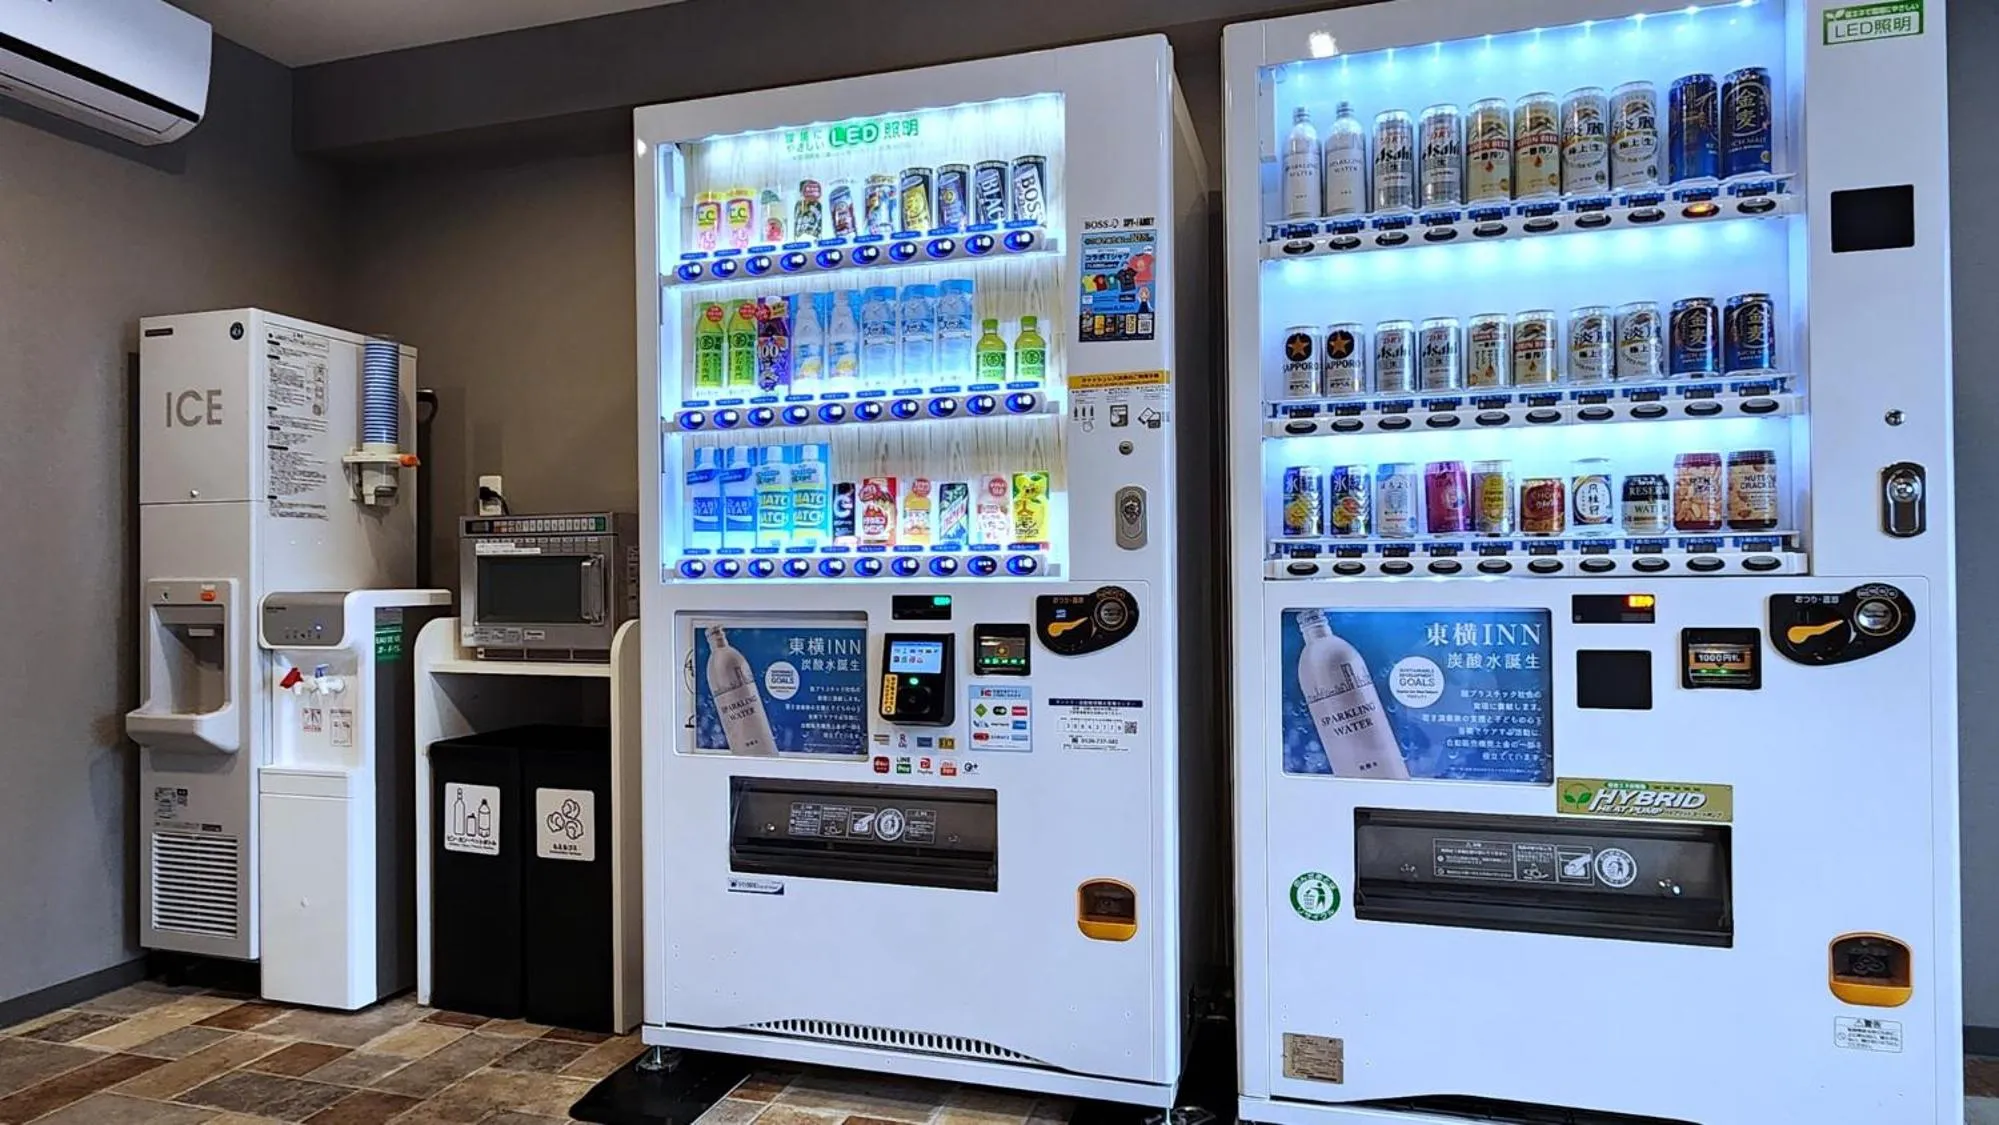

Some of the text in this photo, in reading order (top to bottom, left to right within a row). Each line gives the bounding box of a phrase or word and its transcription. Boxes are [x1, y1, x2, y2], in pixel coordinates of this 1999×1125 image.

[1834, 15, 1912, 38] LED照明
[1736, 88, 1757, 130] 金麦
[829, 123, 879, 147] LED
[884, 118, 919, 140] 照明
[166, 389, 222, 427] ICE
[1426, 622, 1543, 647] 東横INN
[788, 637, 862, 656] 東横INN
[1699, 654, 1741, 662] 1000円札
[801, 659, 861, 671] 炭酸水誕生
[1446, 652, 1542, 670] 炭酸水誕生
[1399, 678, 1436, 687] GOALS
[1321, 702, 1376, 727] SPARKLING
[1333, 717, 1374, 736] WATER
[1589, 788, 1706, 811] HYBRID
